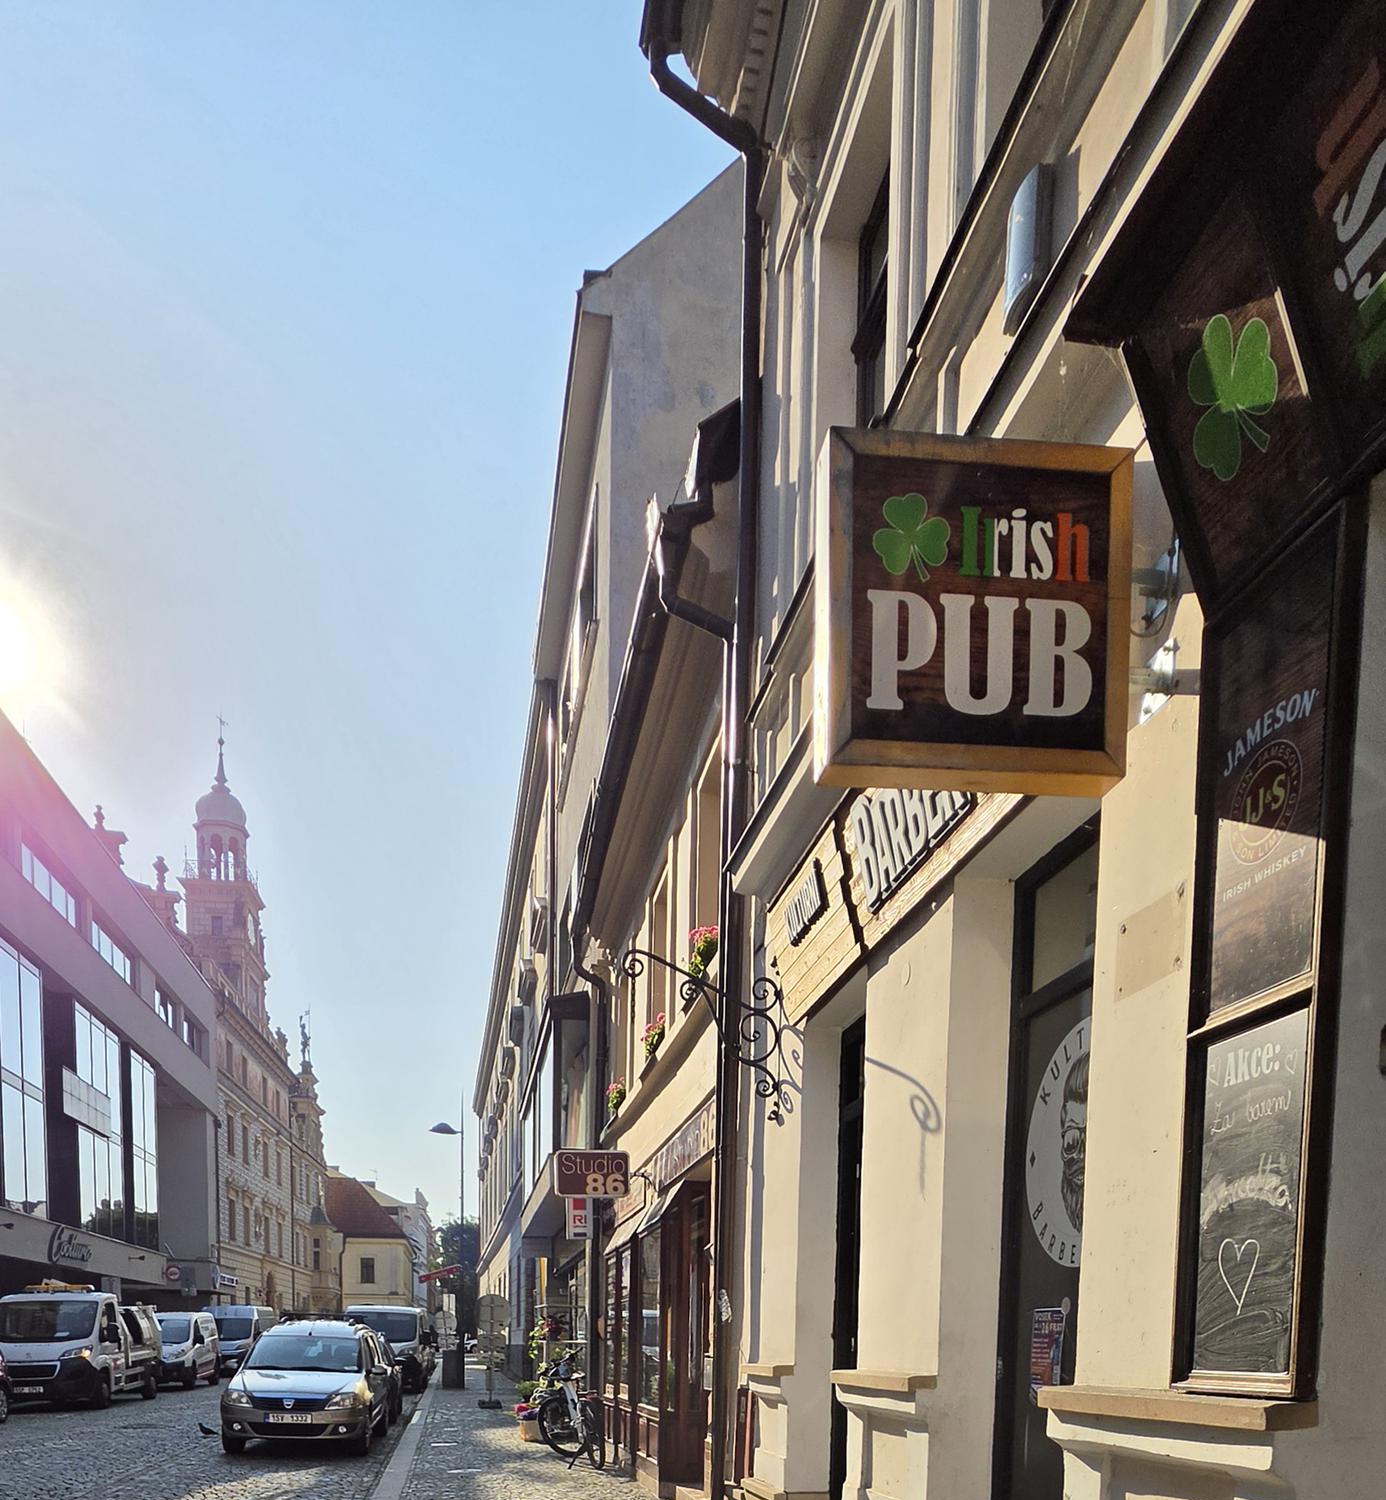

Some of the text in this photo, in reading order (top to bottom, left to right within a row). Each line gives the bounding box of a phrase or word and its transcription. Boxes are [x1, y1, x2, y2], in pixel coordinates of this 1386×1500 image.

[960, 506, 1090, 582] Irish
[866, 589, 1093, 717] PUB
[1223, 688, 1318, 777] JAMESON
[1223, 845, 1307, 902] IRISH WHISKEY
[1040, 1027, 1085, 1106] KULT
[1223, 1042, 1281, 1088] Akce:
[561, 1154, 625, 1175] Studio
[585, 1173, 625, 1195] 86
[1032, 1201, 1077, 1264] BARBE
